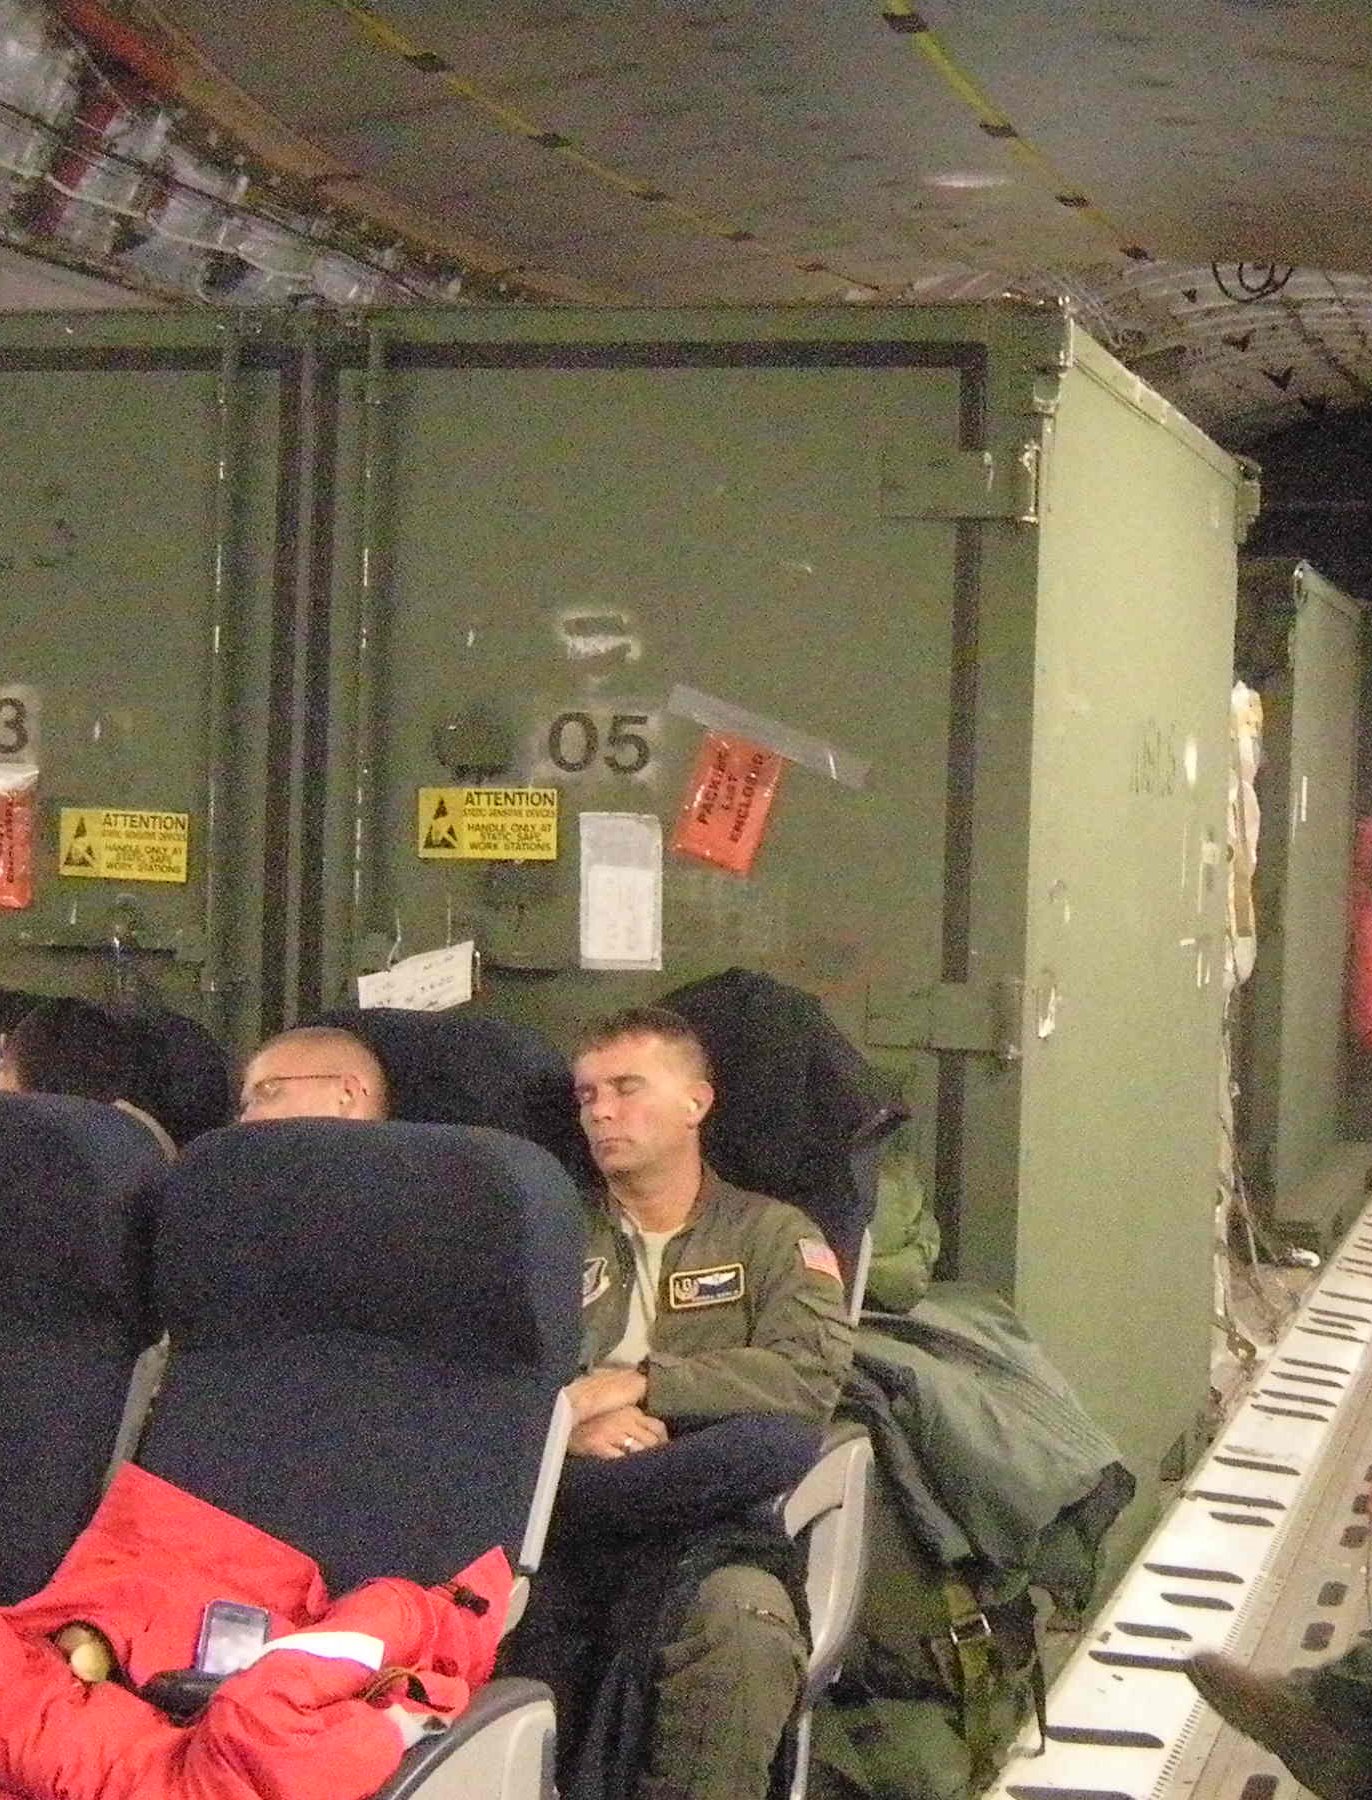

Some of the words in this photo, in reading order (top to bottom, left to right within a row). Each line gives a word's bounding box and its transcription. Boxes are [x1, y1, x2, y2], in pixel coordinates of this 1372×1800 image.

[548, 711, 650, 775] 05
[464, 791, 555, 806] ATTENTION
[103, 813, 187, 831] ATTENTION
